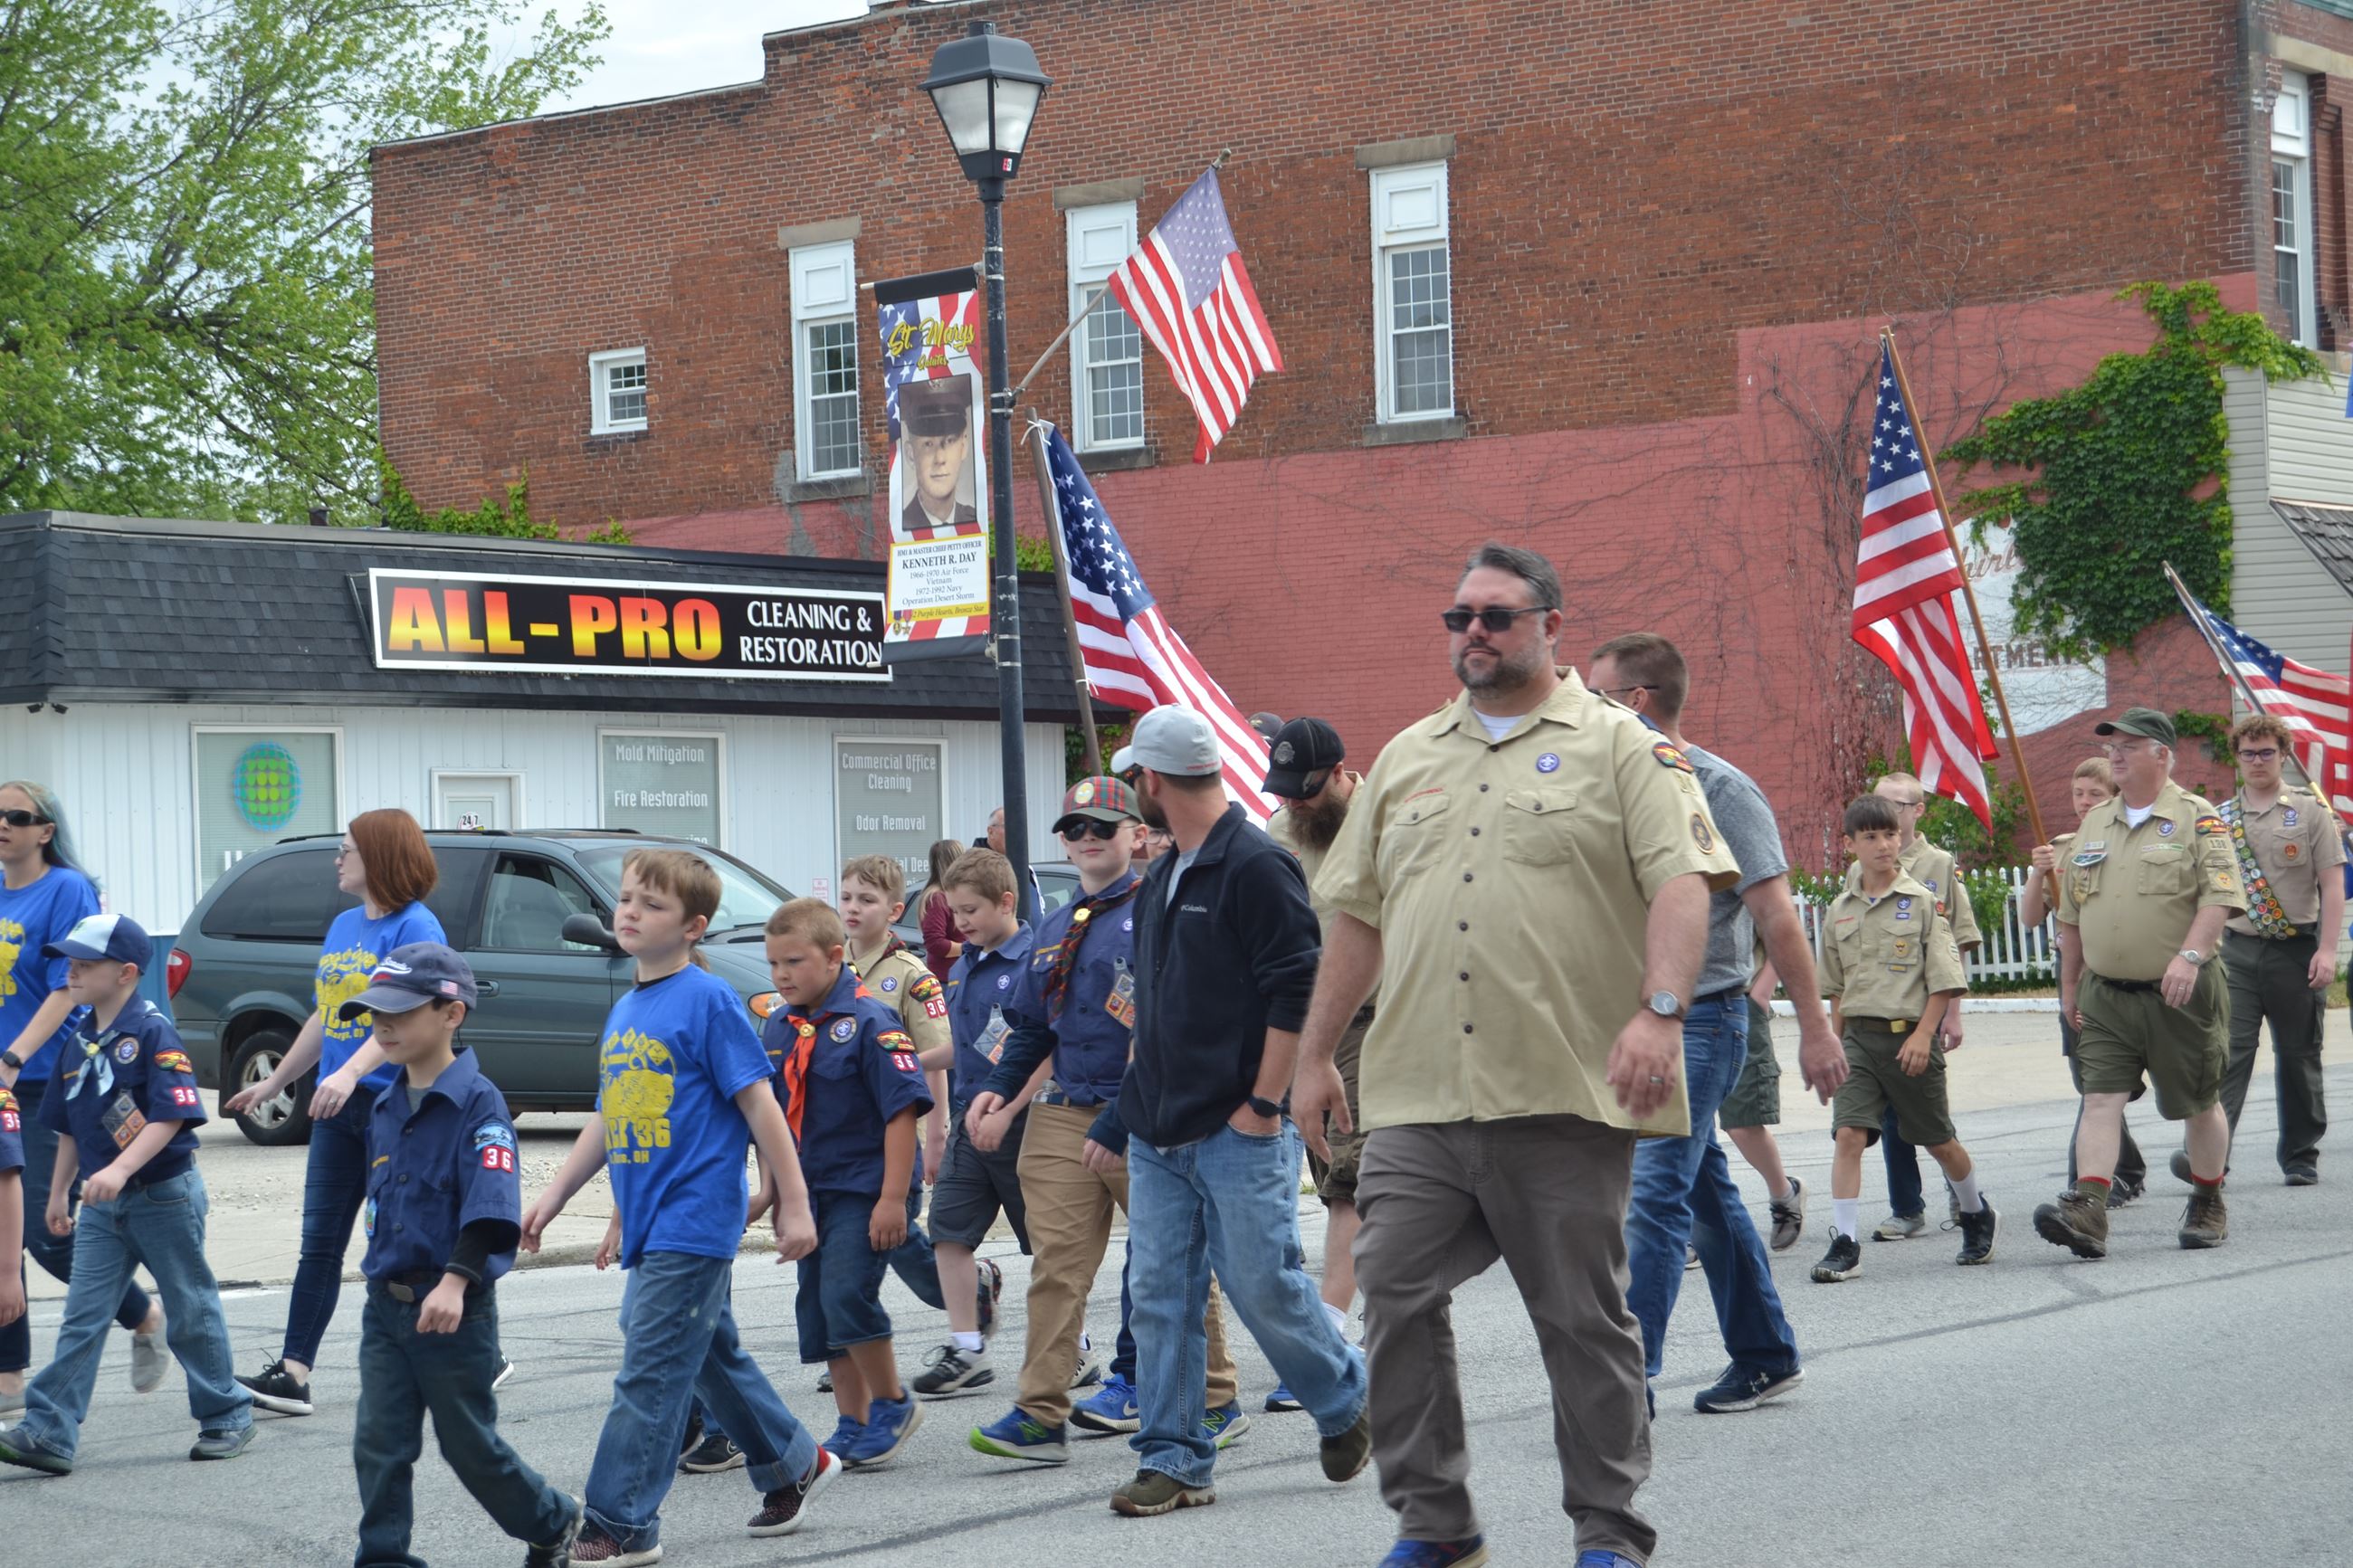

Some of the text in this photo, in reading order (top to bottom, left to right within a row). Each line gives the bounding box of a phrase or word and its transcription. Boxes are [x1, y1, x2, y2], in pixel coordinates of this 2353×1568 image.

[889, 318, 975, 356] St. Marys
[917, 355, 948, 371] Salutes
[913, 546, 932, 555] MASTER
[933, 545, 947, 553] CHIEF
[948, 543, 962, 551] PETTY
[962, 540, 982, 549] OFFICER
[902, 552, 976, 569] KENNETH R. DAY
[910, 569, 939, 579] 1966-1970
[952, 566, 969, 575] Force
[926, 577, 952, 585] Vietnam
[915, 584, 963, 595] 1972-1992 Navy
[901, 592, 975, 607] Operation Desert Storm
[747, 600, 872, 632] CLEANING &
[917, 610, 934, 618] Purple
[739, 635, 883, 666] RESTORATION
[615, 745, 704, 765] Mold Mitigation
[842, 753, 936, 773] Commercial Office
[868, 773, 912, 793] Cleaning
[614, 790, 708, 807] Fire Restoration
[856, 814, 926, 831] Odor Removal
[911, 856, 929, 872] Dee
[926, 999, 947, 1015] 36
[894, 1054, 915, 1069] 36
[175, 1088, 196, 1103] 36
[636, 1117, 671, 1147] 36
[487, 1147, 511, 1169] 36
